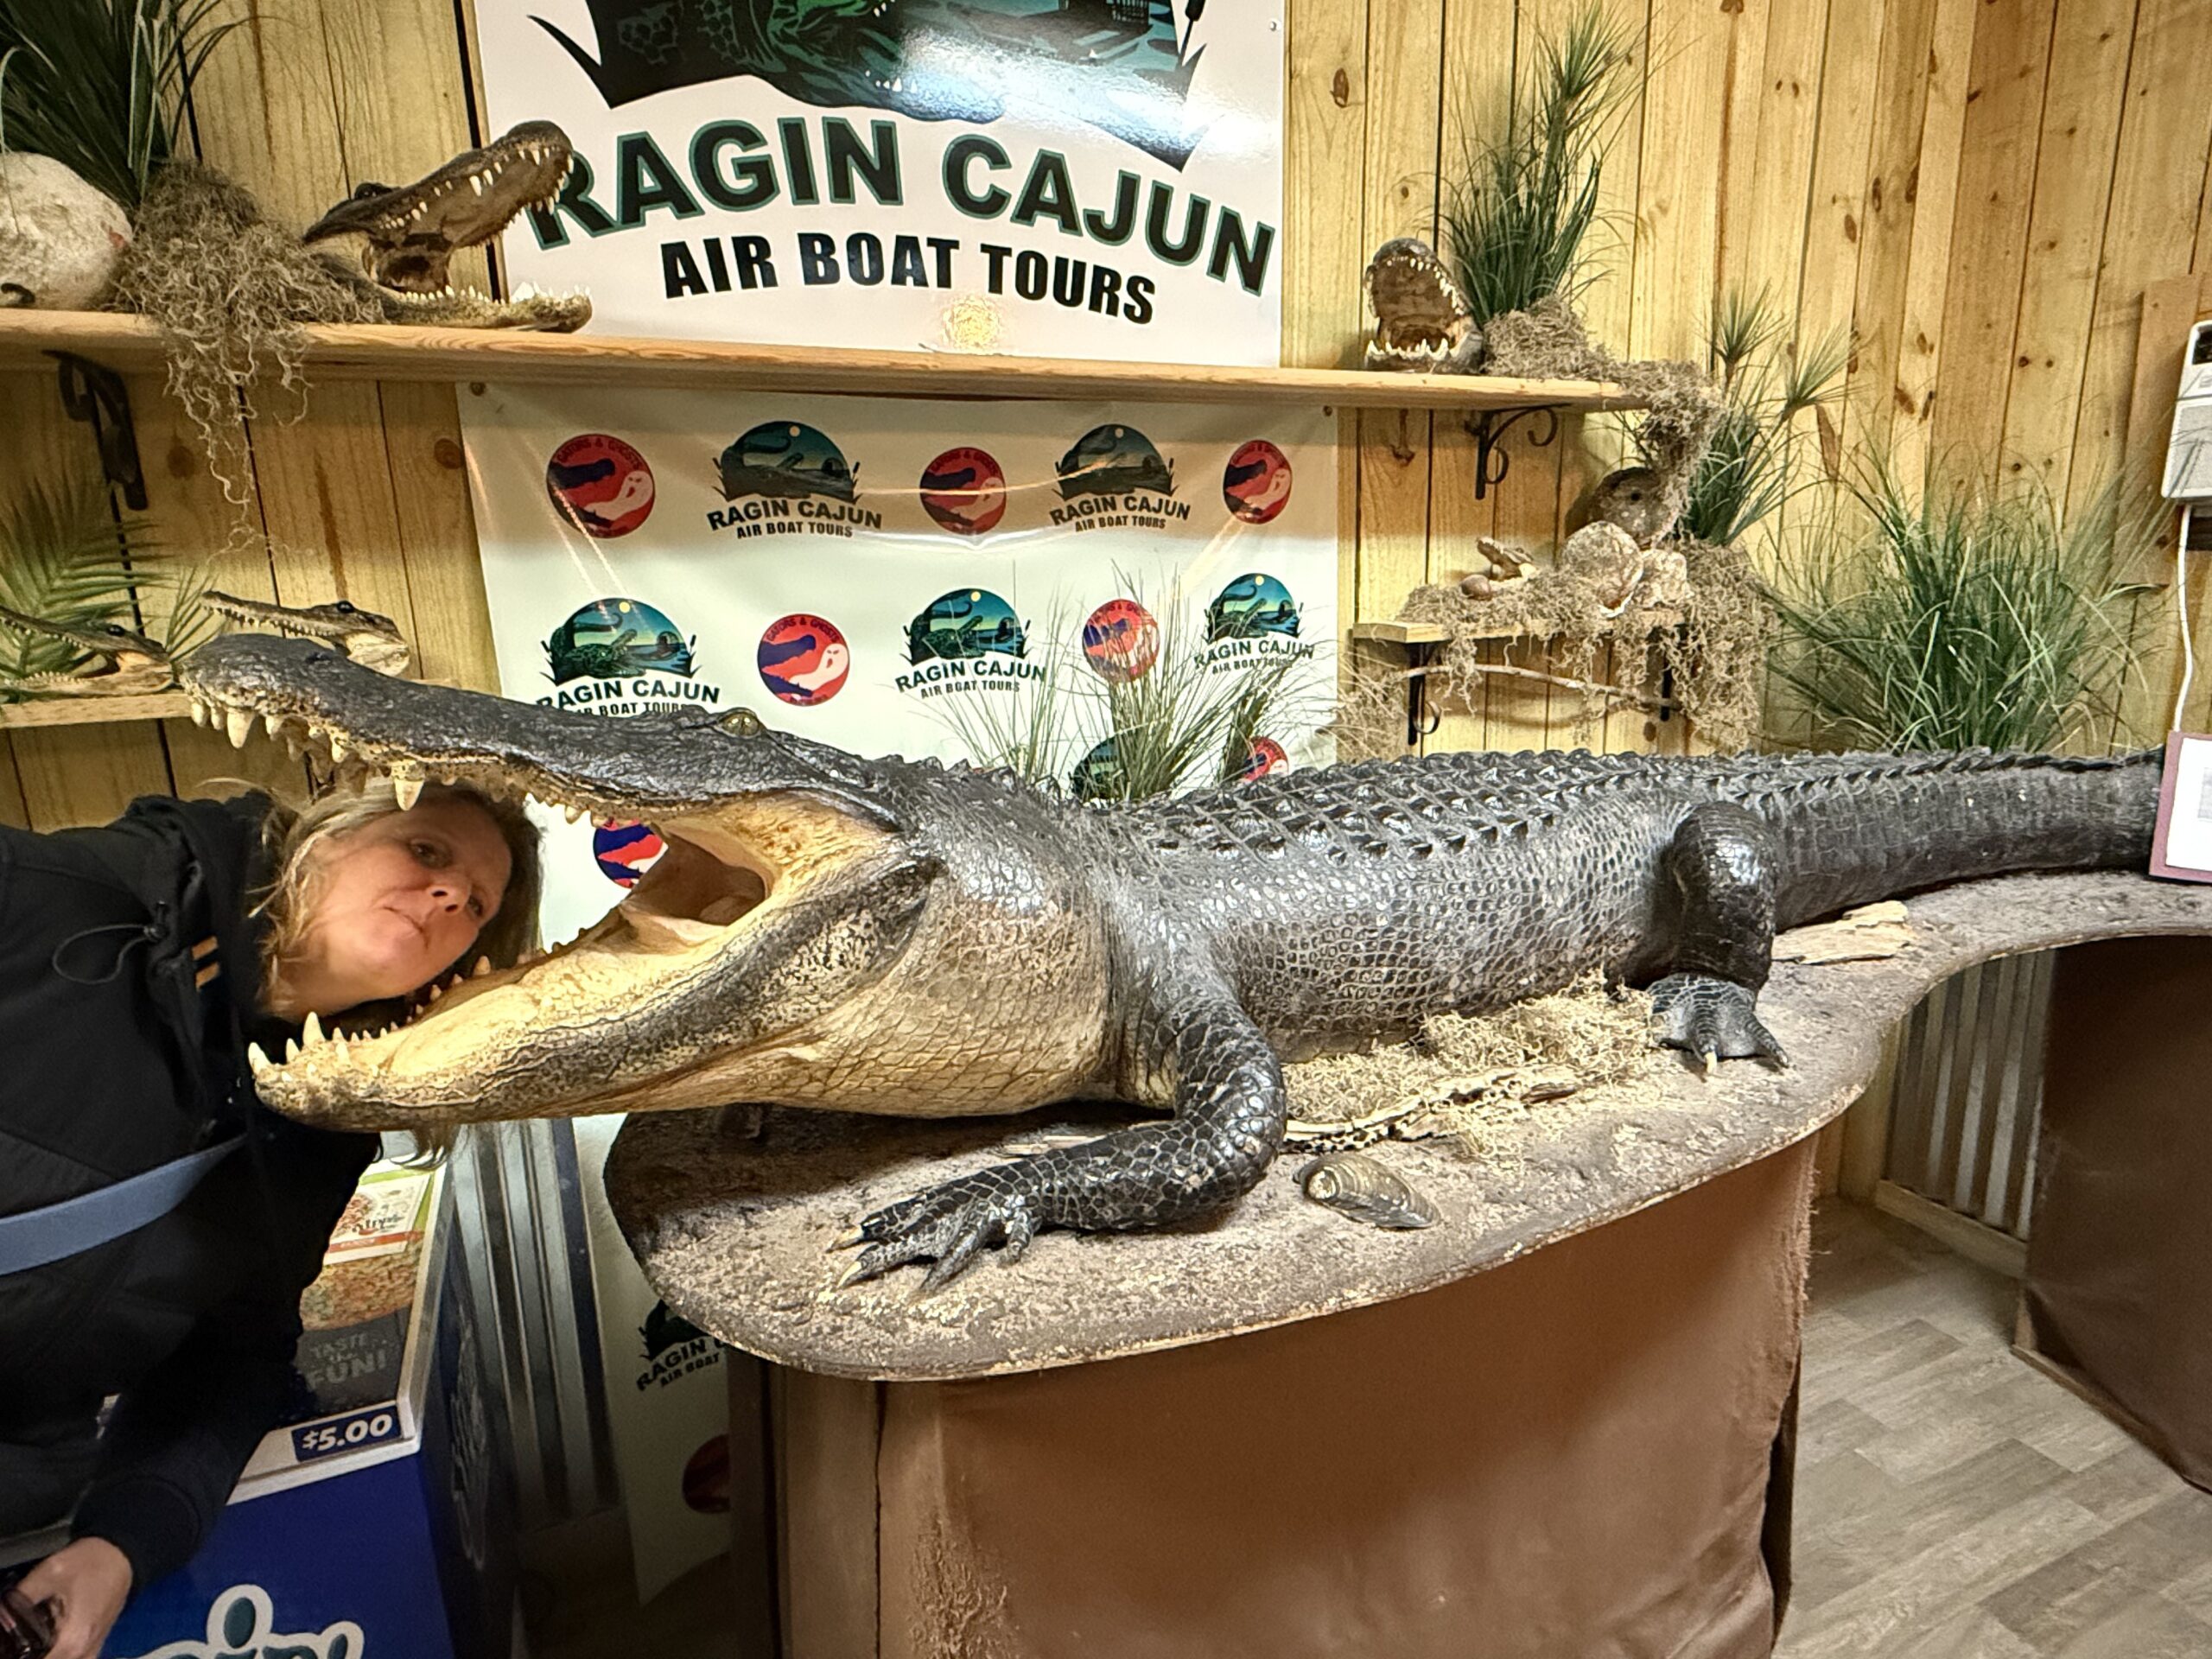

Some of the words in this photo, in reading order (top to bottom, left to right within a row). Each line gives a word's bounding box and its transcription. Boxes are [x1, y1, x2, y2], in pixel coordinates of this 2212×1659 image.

[523, 117, 904, 251] RAGIN
[942, 134, 1274, 297] CAJUN
[661, 234, 775, 299] AIR
[797, 232, 960, 290] BOAT
[979, 244, 1157, 325] TOURS
[706, 499, 791, 531] RAGIN
[797, 500, 882, 530] CAJUN
[1049, 495, 1117, 526] RAGIN
[1123, 495, 1191, 521] CAJUN
[1075, 518, 1096, 532] AIR
[1098, 515, 1129, 528] BOAT
[1131, 515, 1166, 530] TOURS
[737, 523, 762, 539] AIR
[766, 521, 804, 535] BOAT
[807, 521, 853, 538] TOURS
[1194, 640, 1252, 670] RAGIN
[1258, 639, 1315, 659] CAJUN
[1211, 662, 1232, 675] AIR
[632, 679, 721, 704] CAJUN
[894, 660, 966, 693] RAGIN
[973, 660, 1047, 683] CAJUN
[920, 684, 943, 699] AIR
[945, 680, 978, 694] BOAT
[982, 679, 1020, 692] TOURS
[599, 702, 639, 716] BOAT
[637, 1338, 707, 1392] RAGIN
[660, 1369, 683, 1388] AIR
[685, 1352, 720, 1373] BOAT
[302, 1413, 394, 1452] $5.00
